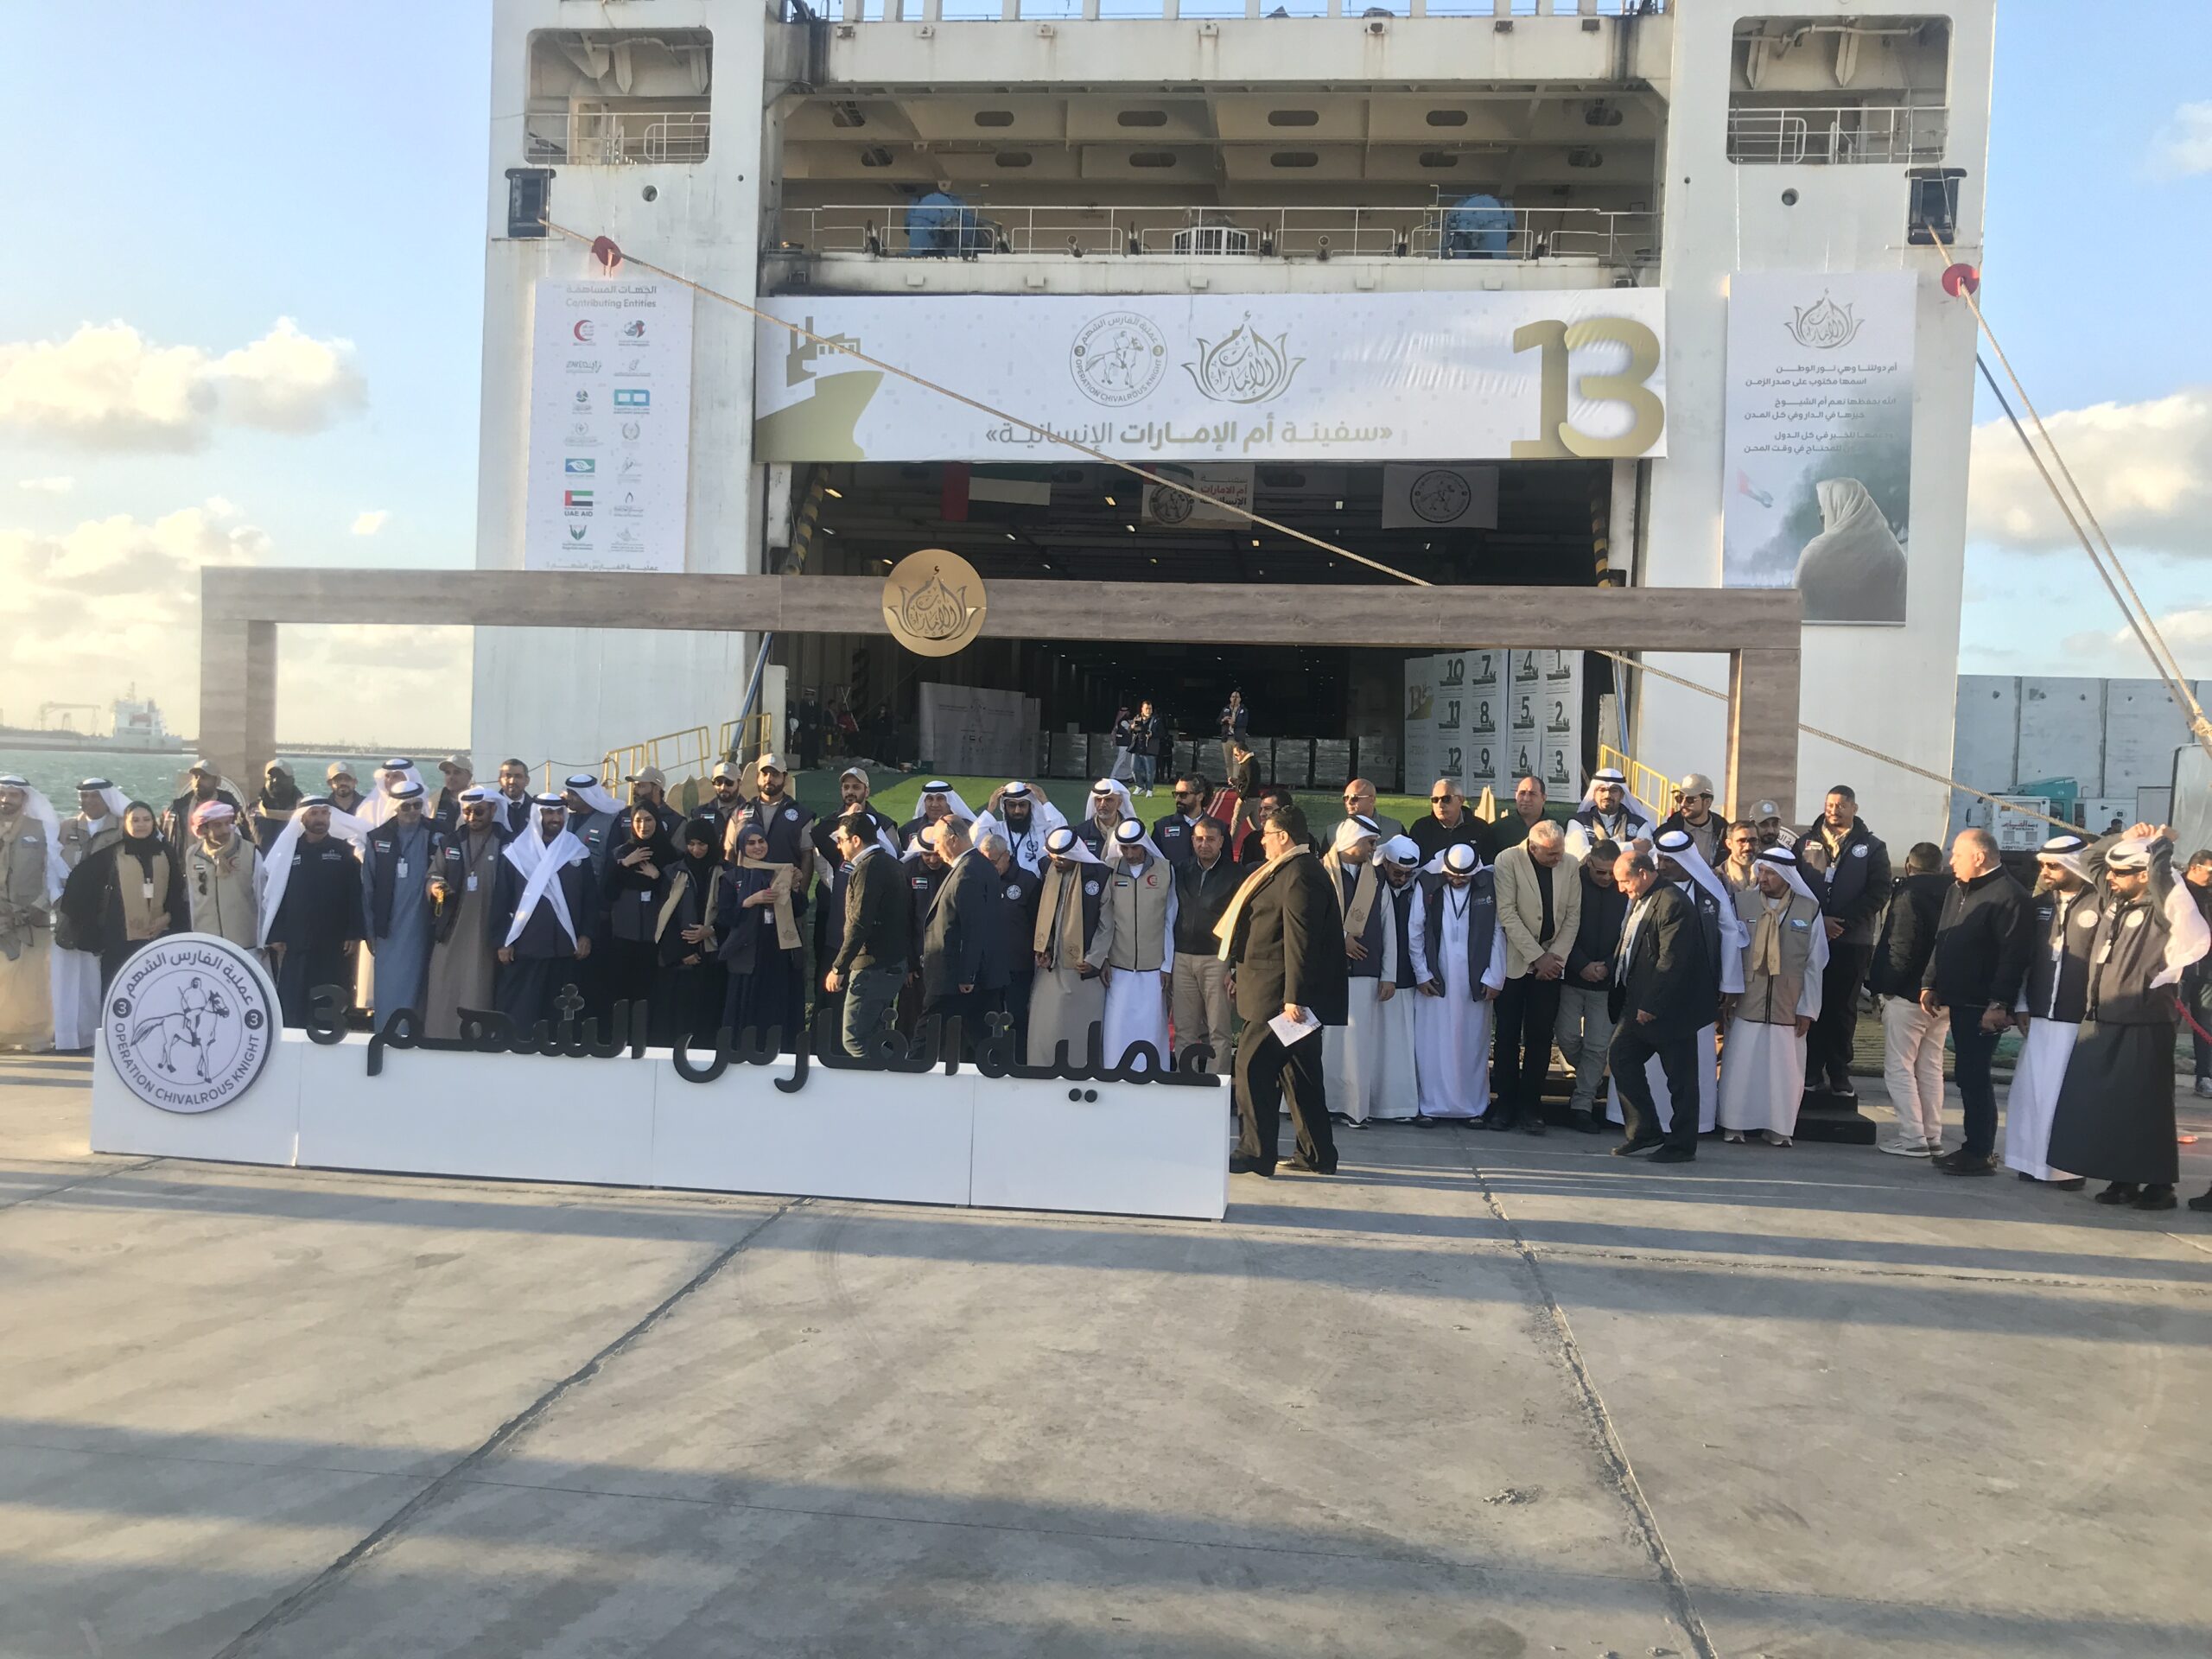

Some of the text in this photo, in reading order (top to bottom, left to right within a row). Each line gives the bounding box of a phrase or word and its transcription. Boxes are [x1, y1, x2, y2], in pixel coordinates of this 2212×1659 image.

[566, 298, 657, 308] Contributing Entities
[1082, 319, 1106, 346] الشهم
[1108, 315, 1140, 327] الفارس
[1076, 359, 1161, 403] OPERATION CHIVALROUS KNIGHT
[1510, 317, 1665, 458] 13
[1121, 421, 1237, 452] الإمارات
[1243, 412, 1274, 454] أم
[1447, 658, 1465, 680] 10
[1482, 654, 1491, 675] 7
[1523, 651, 1533, 671] 4
[1448, 700, 1460, 724] 11
[1480, 701, 1490, 724] 8
[1521, 696, 1530, 720] 5
[1555, 701, 1563, 721] 2
[1448, 747, 1462, 767] 12
[1480, 747, 1491, 769] 9
[1519, 745, 1528, 768] 6
[1555, 750, 1563, 773] 3
[126, 950, 254, 1006] عملية الفارس الشهم
[305, 983, 350, 1046] 3
[366, 983, 1222, 1103] عملية الفارس الشهم
[115, 1022, 260, 1105] OPERATION CHIVALROUS KNIGHT
